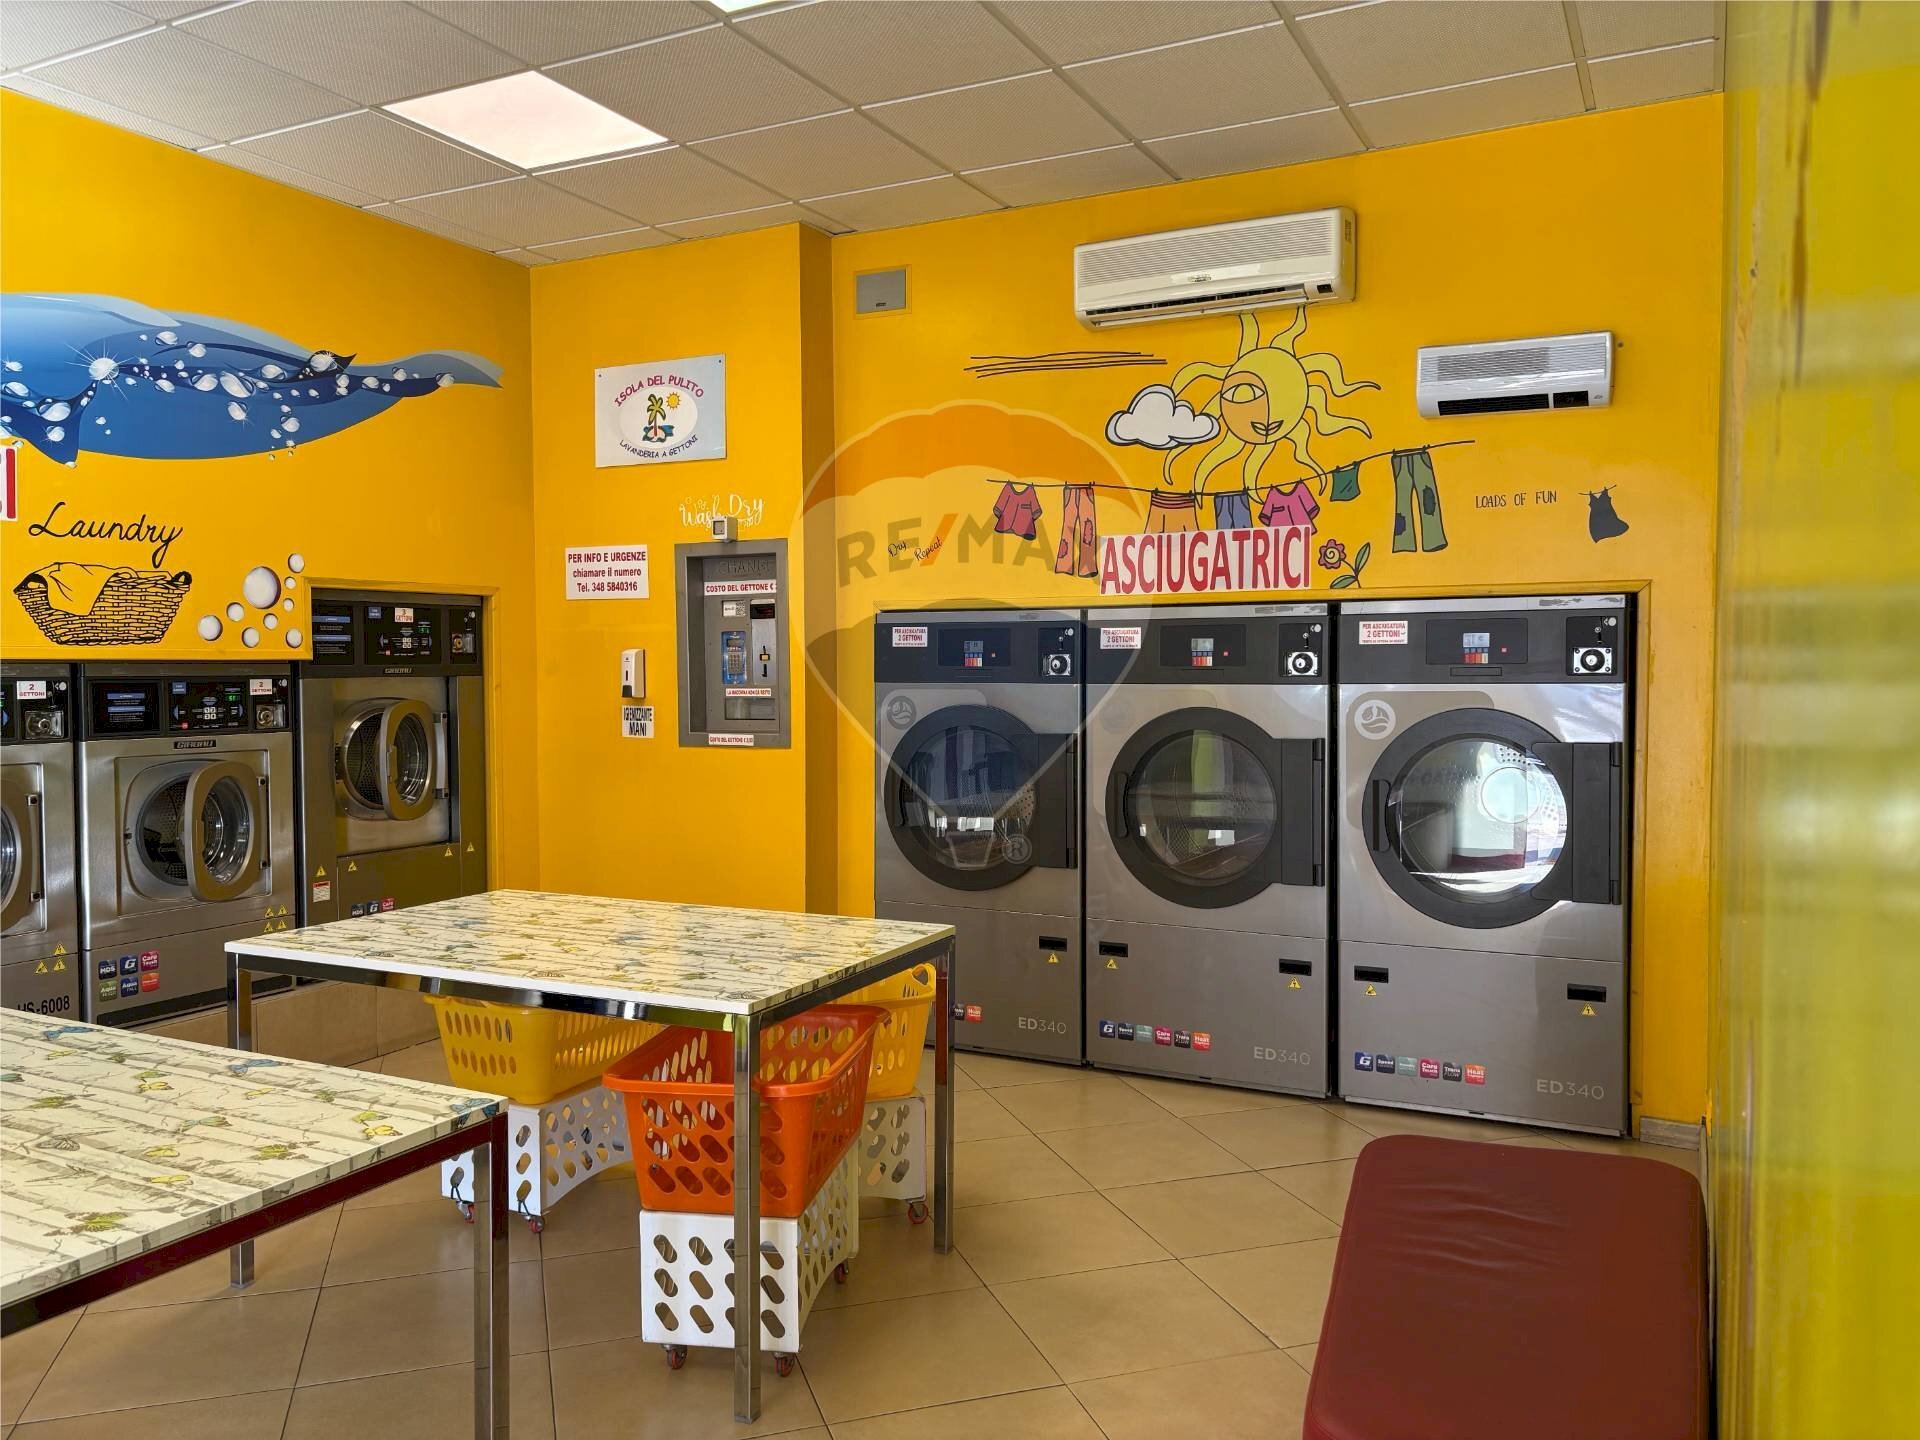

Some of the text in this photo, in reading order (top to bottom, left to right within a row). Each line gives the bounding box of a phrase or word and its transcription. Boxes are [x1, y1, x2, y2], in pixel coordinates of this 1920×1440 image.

[614, 375, 704, 407] ISOLA DEL PULITO
[620, 439, 659, 459] LAVANDERIA
[669, 434, 698, 456] GETTONI
[1475, 490, 1557, 508] LOADS OF FUN
[727, 493, 764, 526] Dry
[28, 502, 184, 569] Laundry
[914, 536, 942, 561] Repeat
[568, 551, 646, 563] PER INFO E URGENZE
[1101, 526, 1310, 595] ASCIUGATRICI
[573, 567, 641, 578] chiamare il numero
[719, 559, 775, 574] CHANG
[577, 581, 637, 592] Tel. 348 5840316
[727, 584, 739, 592] DEL
[740, 583, 769, 591] GETTONE
[1111, 635, 1135, 643] GETTONI
[1367, 630, 1401, 638] 2 GETTONI
[628, 721, 647, 736] MANI
[125, 958, 137, 969] G
[1018, 1017, 1067, 1034] ED340
[1253, 1046, 1311, 1066] ED340
[1360, 1056, 1372, 1066] G
[1536, 1079, 1605, 1100] ED340
